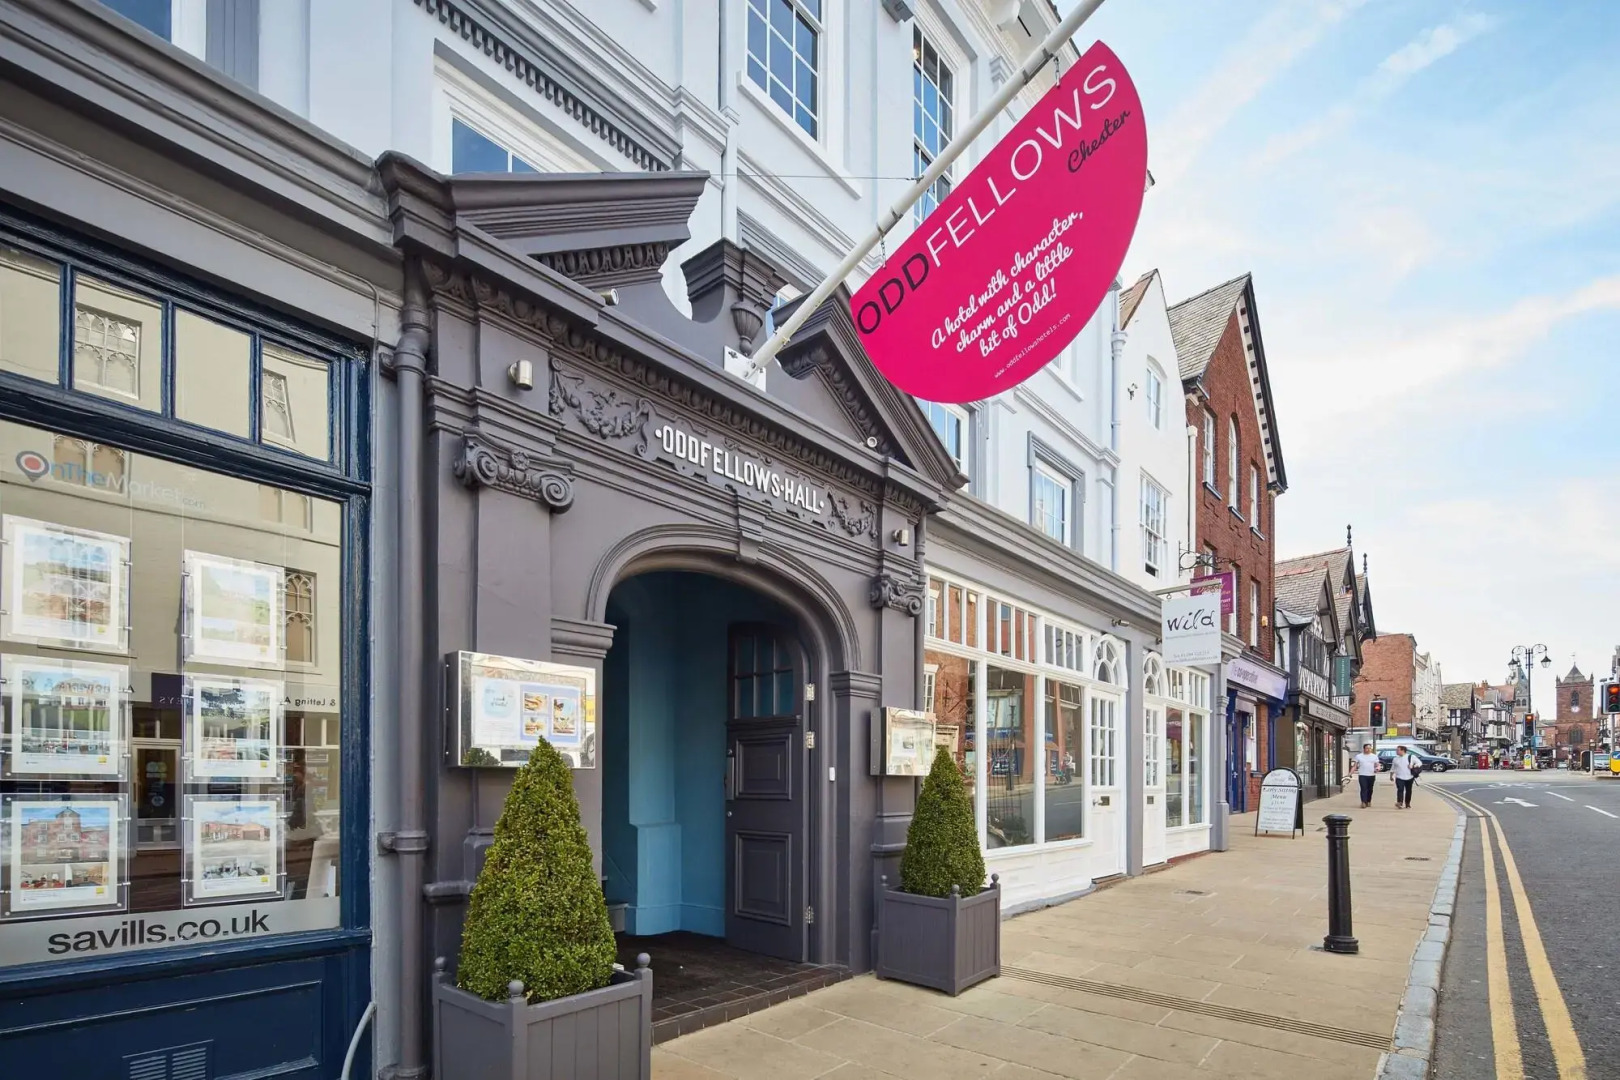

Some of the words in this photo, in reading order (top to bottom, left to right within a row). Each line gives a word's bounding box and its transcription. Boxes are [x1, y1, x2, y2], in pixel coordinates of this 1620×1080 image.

[1067, 110, 1131, 174] Chester
[857, 63, 1117, 335] ODDFELLOWS
[931, 327, 946, 349] A
[944, 294, 979, 336] hotel
[977, 269, 1009, 307] with
[1010, 211, 1084, 278] character,
[956, 314, 996, 352] charm
[996, 281, 1024, 318] and
[1025, 279, 1036, 293] a
[1034, 241, 1074, 281] little
[979, 330, 1002, 357] bit
[1002, 314, 1019, 339] of
[1018, 278, 1057, 324] Odd!
[994, 313, 1071, 379] www.oddfellowshotels.com
[47, 909, 271, 955] savills.co.uk
